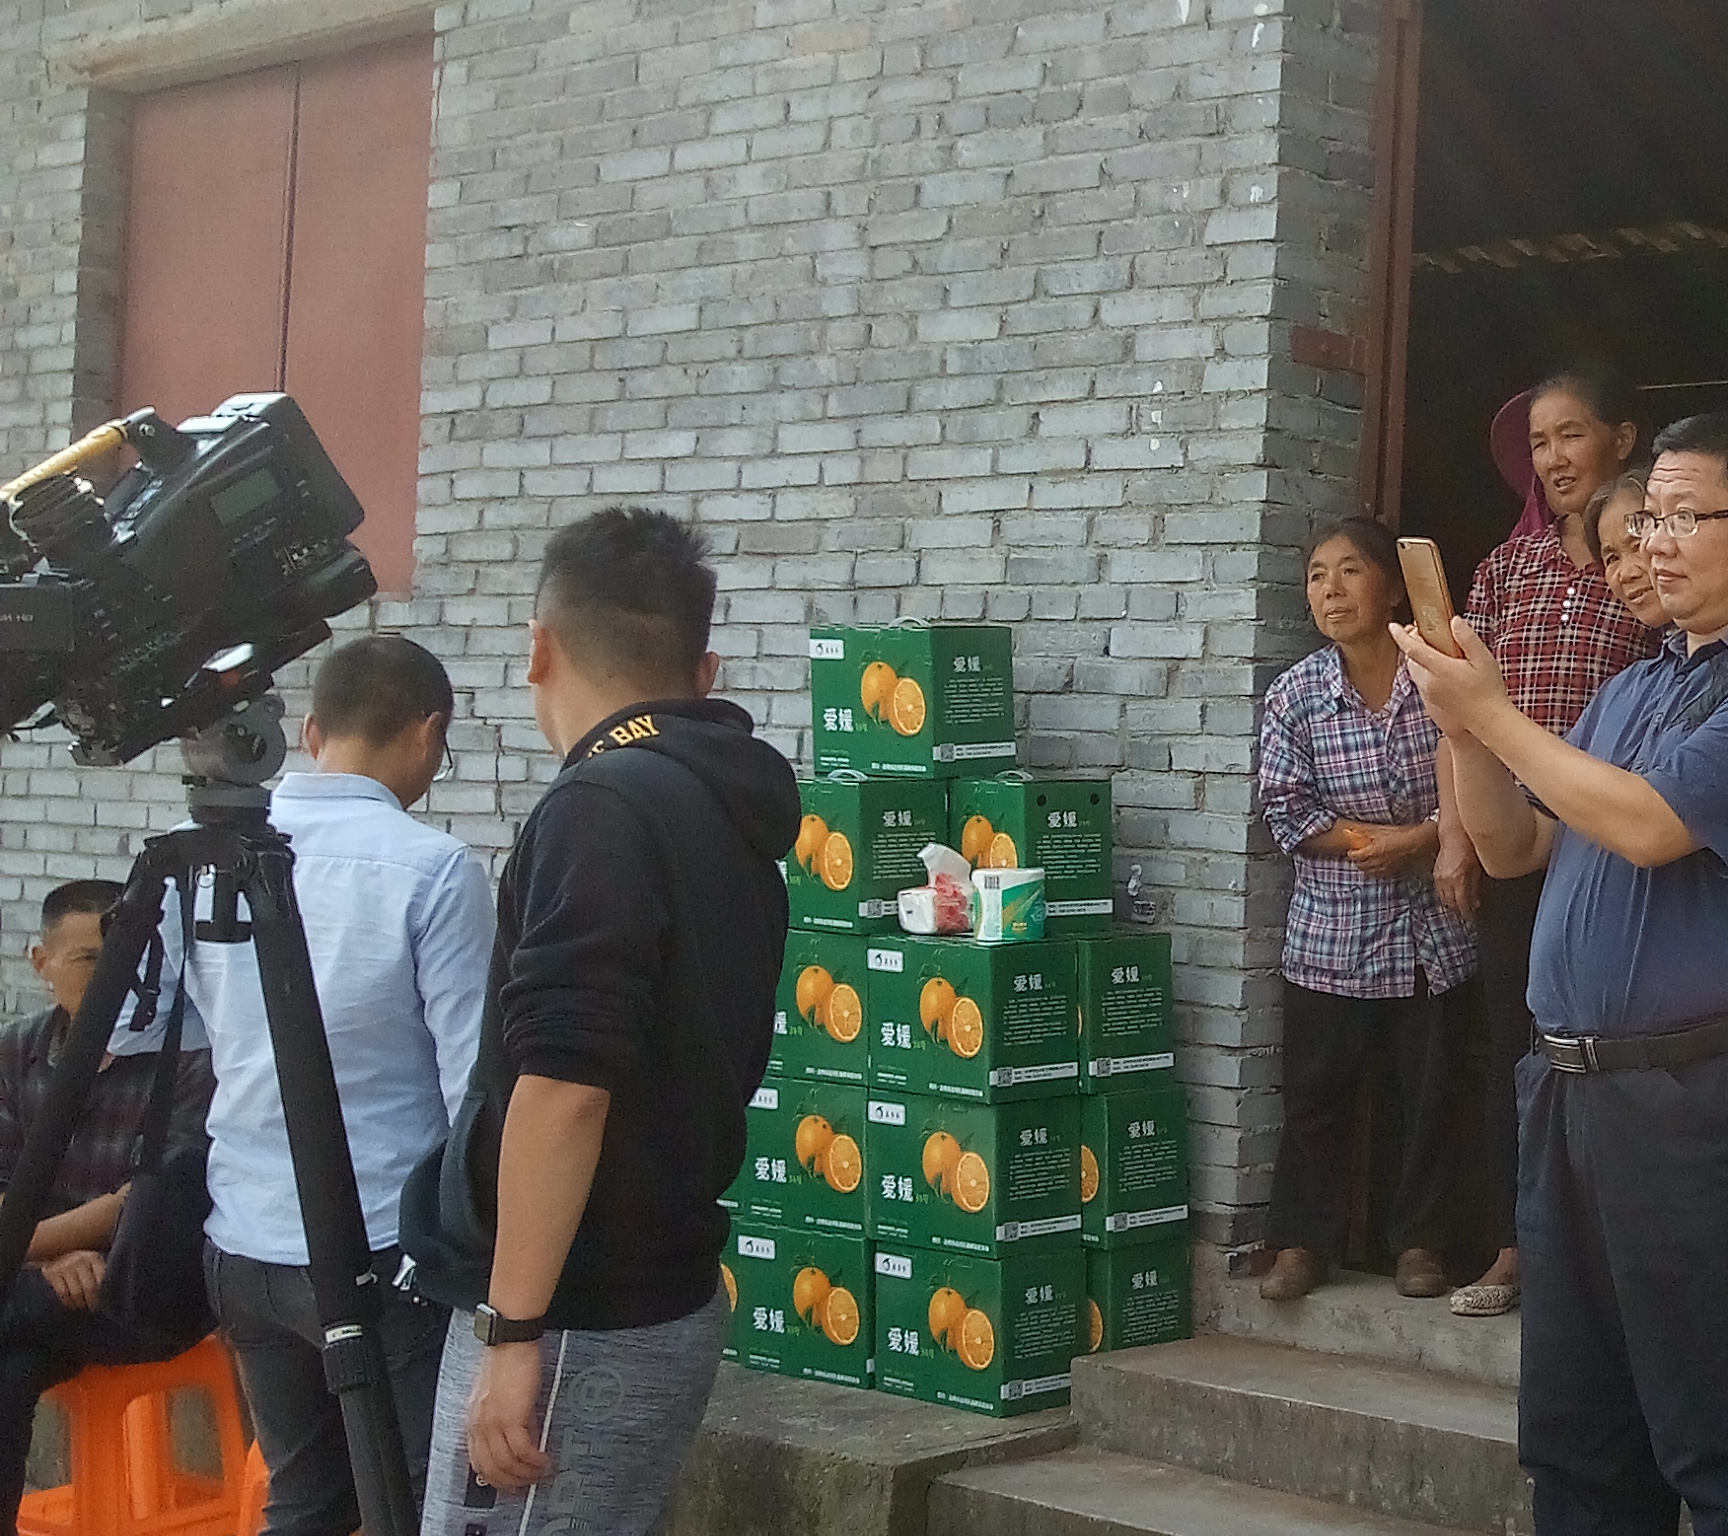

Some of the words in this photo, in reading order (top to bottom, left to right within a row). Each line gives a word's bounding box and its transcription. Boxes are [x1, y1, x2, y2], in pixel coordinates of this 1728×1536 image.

[609, 714, 660, 746] BAY
[881, 1022, 912, 1049] 爱媛
[755, 1157, 787, 1183] 爱媛
[882, 1175, 914, 1203] 爱媛
[753, 1307, 785, 1333] 爱媛
[888, 1327, 920, 1356] 爱媛
